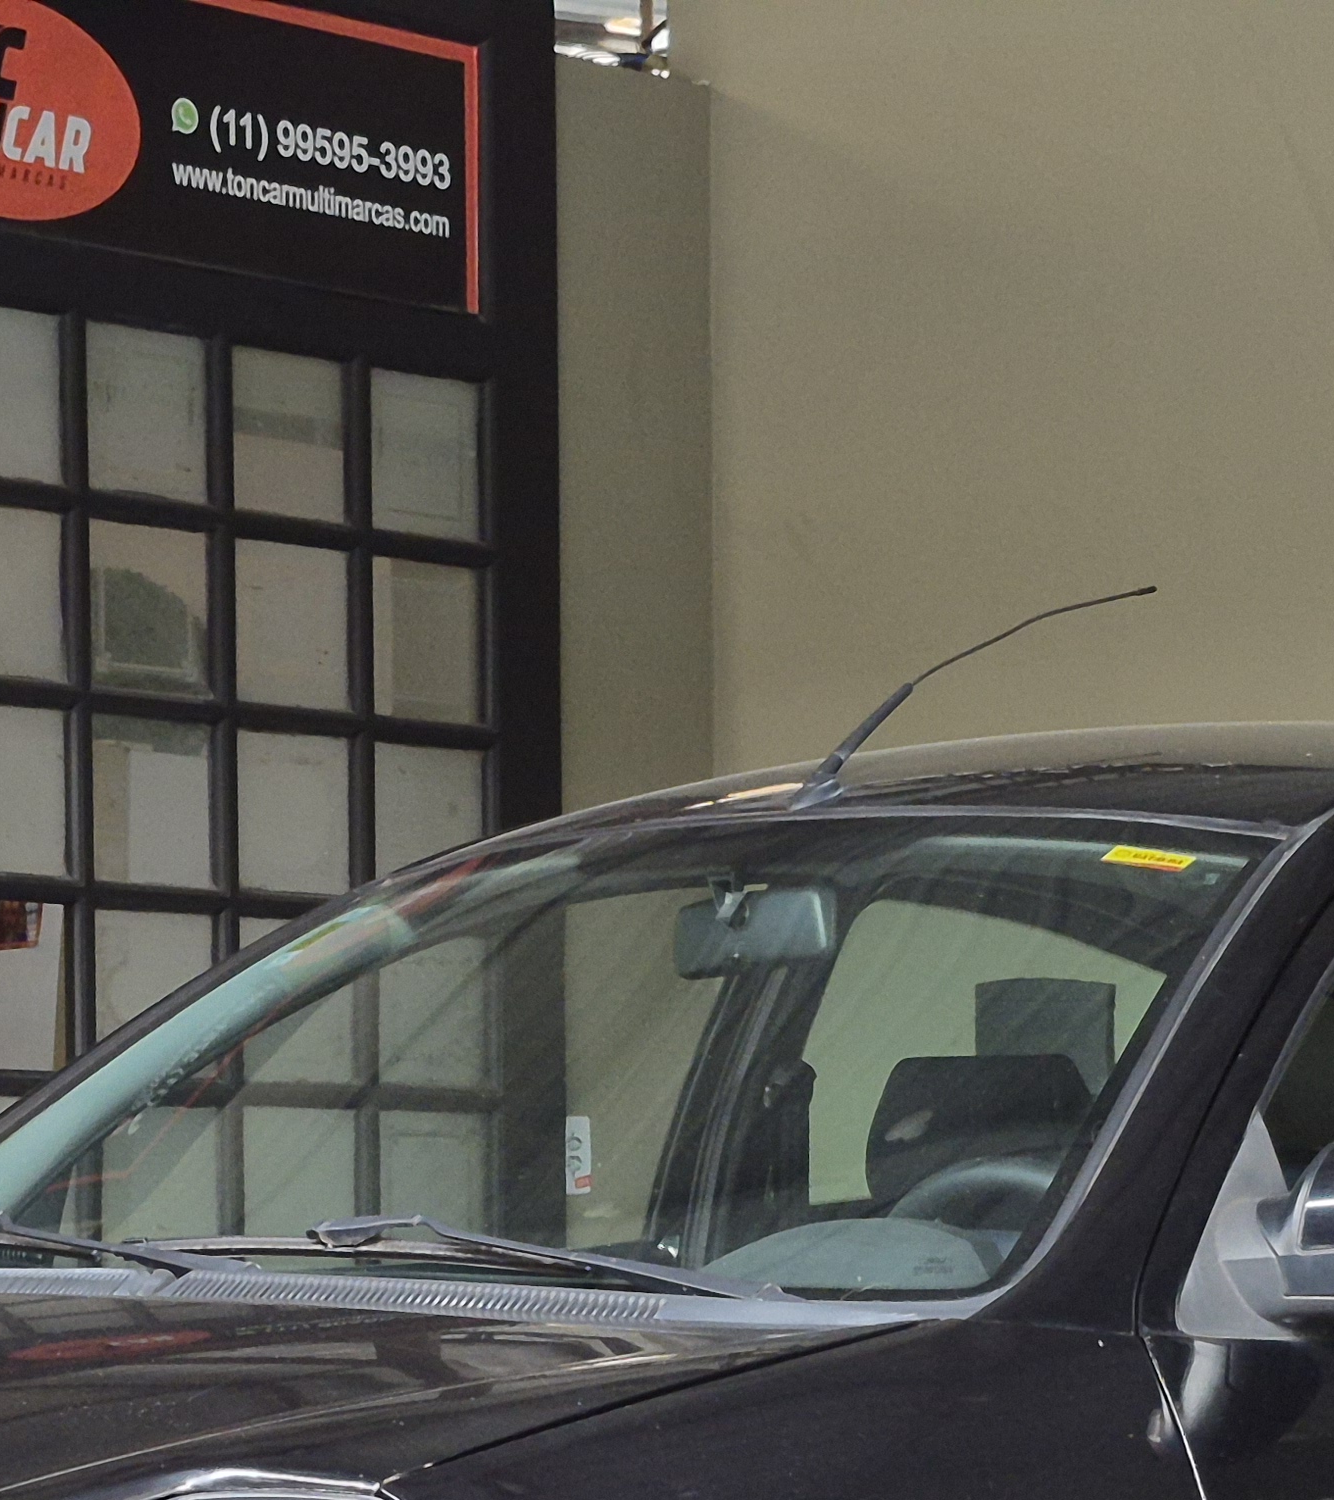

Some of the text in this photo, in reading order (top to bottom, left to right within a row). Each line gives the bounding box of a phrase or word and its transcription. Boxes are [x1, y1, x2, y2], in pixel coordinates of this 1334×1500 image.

[209, 105, 452, 190] (11) 99595-3993
[171, 162, 451, 239] www.toncarmultimarcas.com
